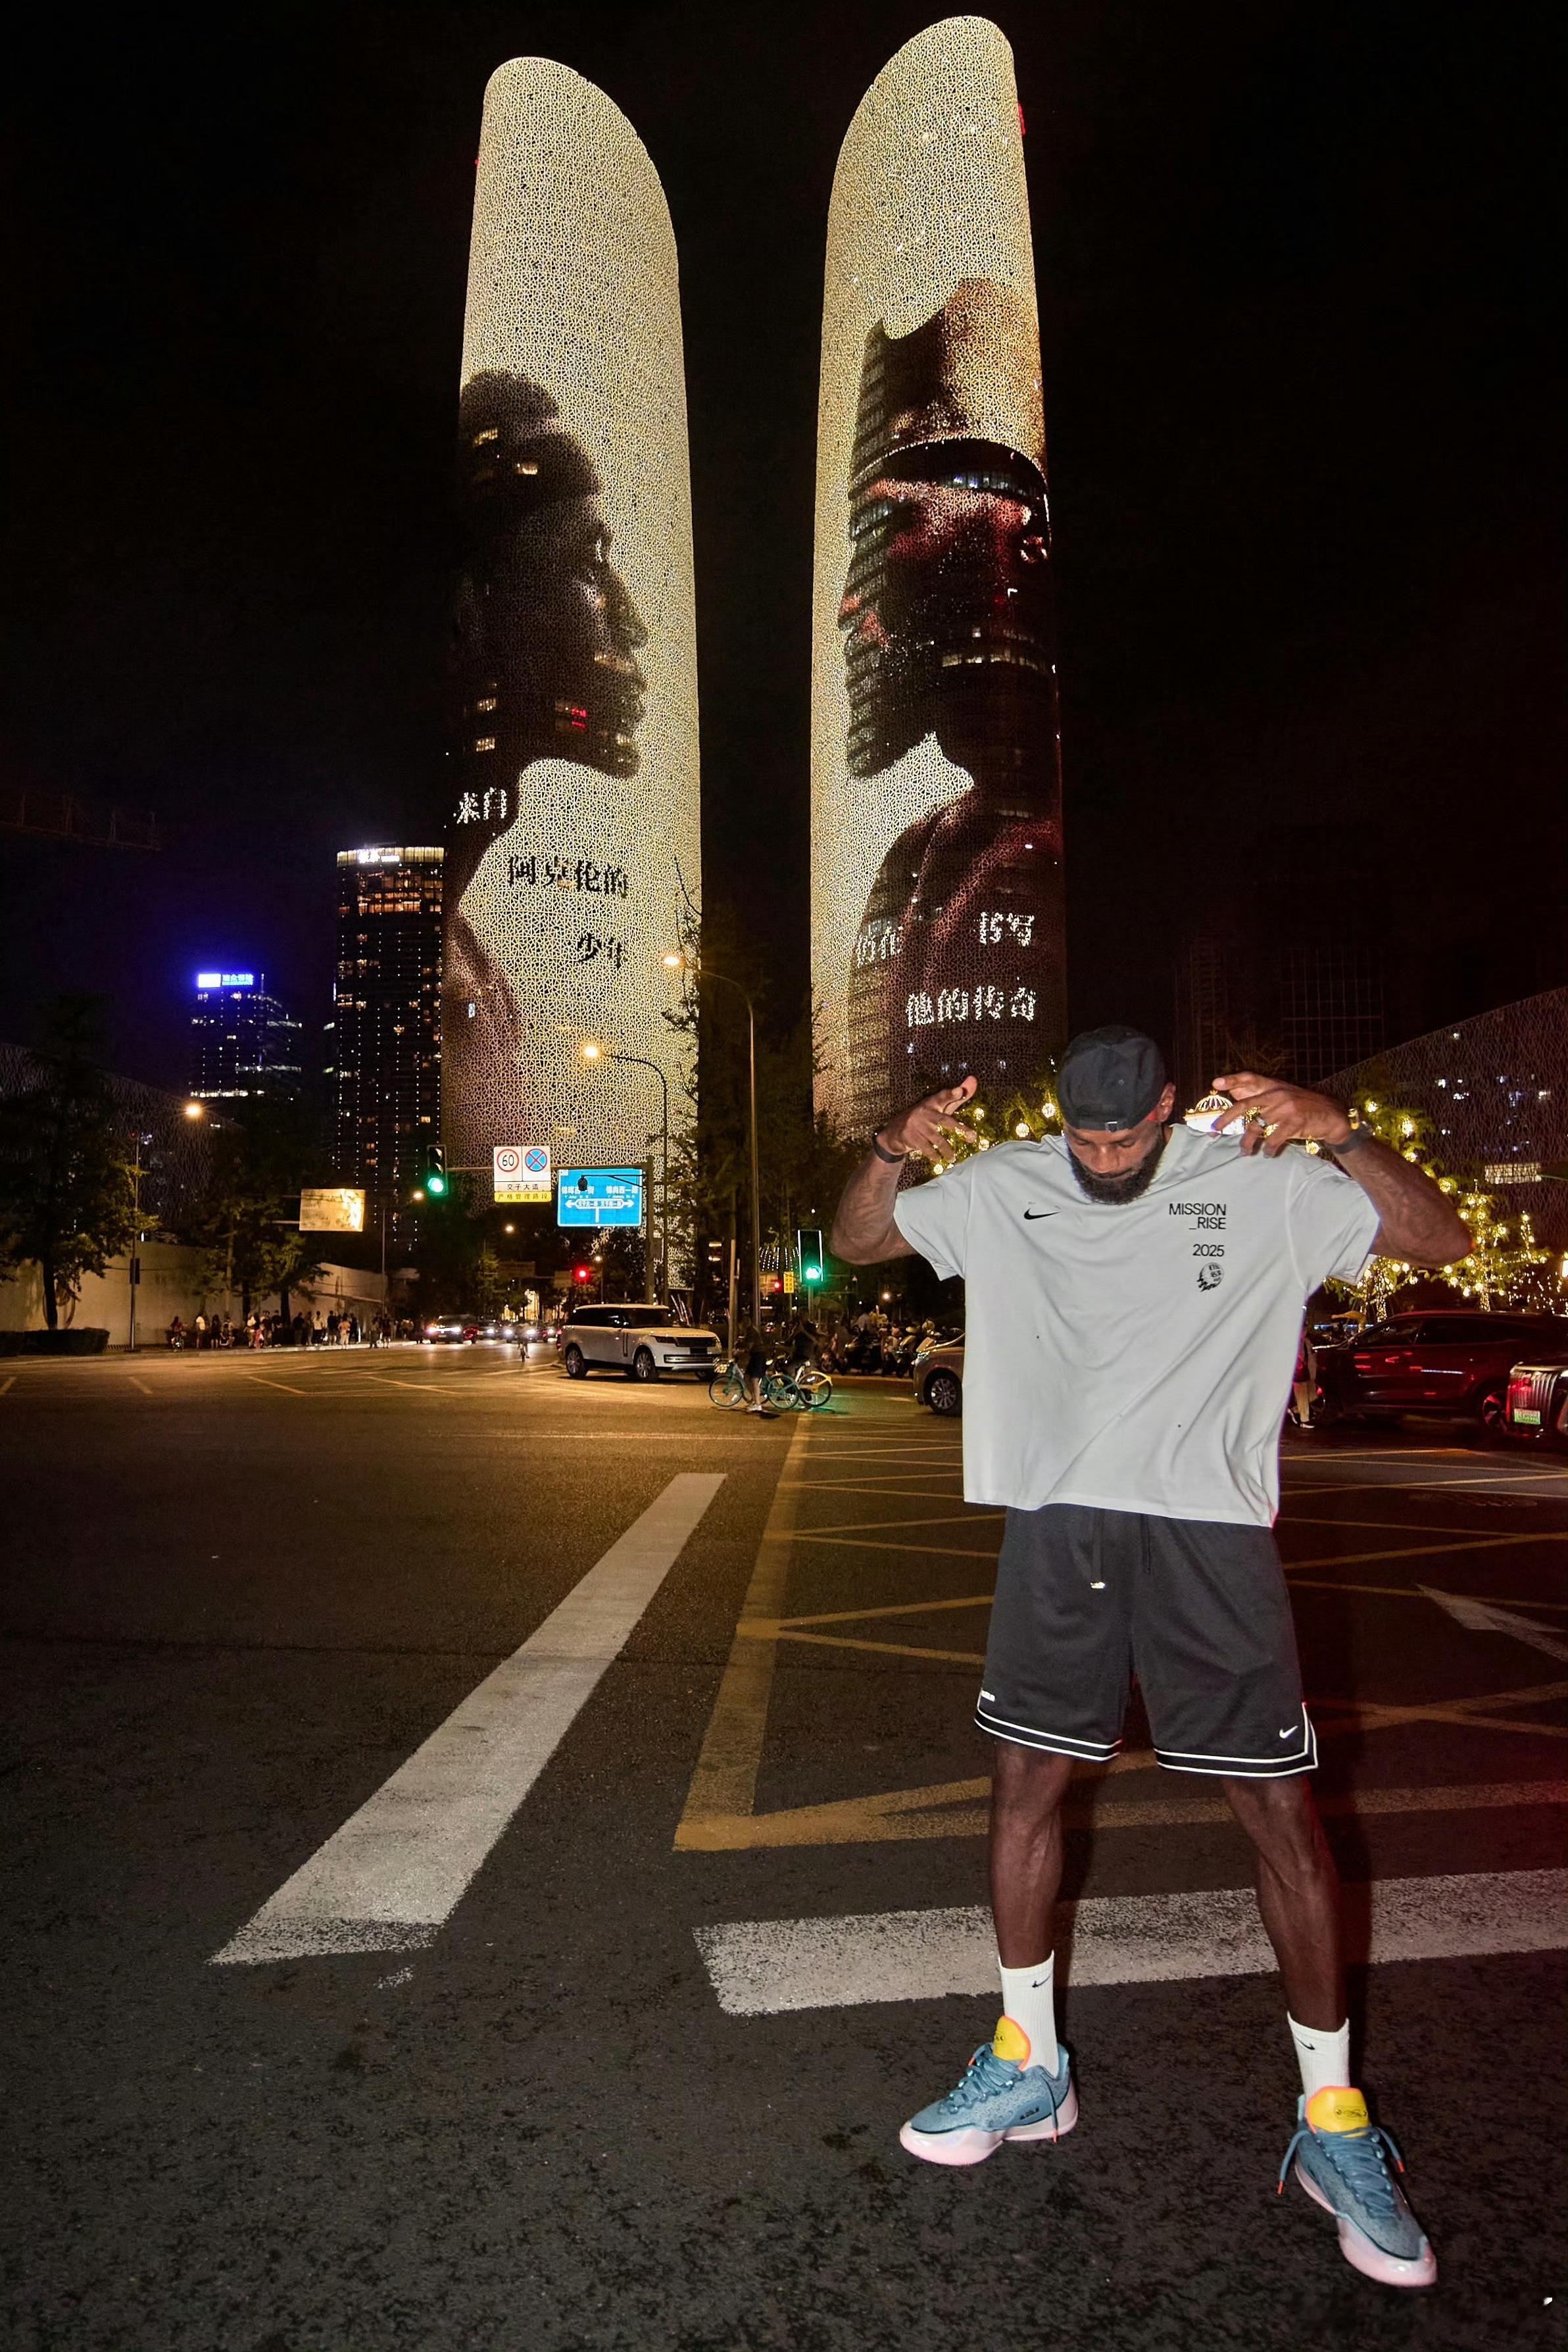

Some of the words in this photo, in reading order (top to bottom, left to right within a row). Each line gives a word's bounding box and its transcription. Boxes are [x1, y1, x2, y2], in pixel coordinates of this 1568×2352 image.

[502, 1154, 514, 1167] 60
[1169, 1203, 1226, 1215] MISSION
[1192, 1244, 1225, 1257] 2025
